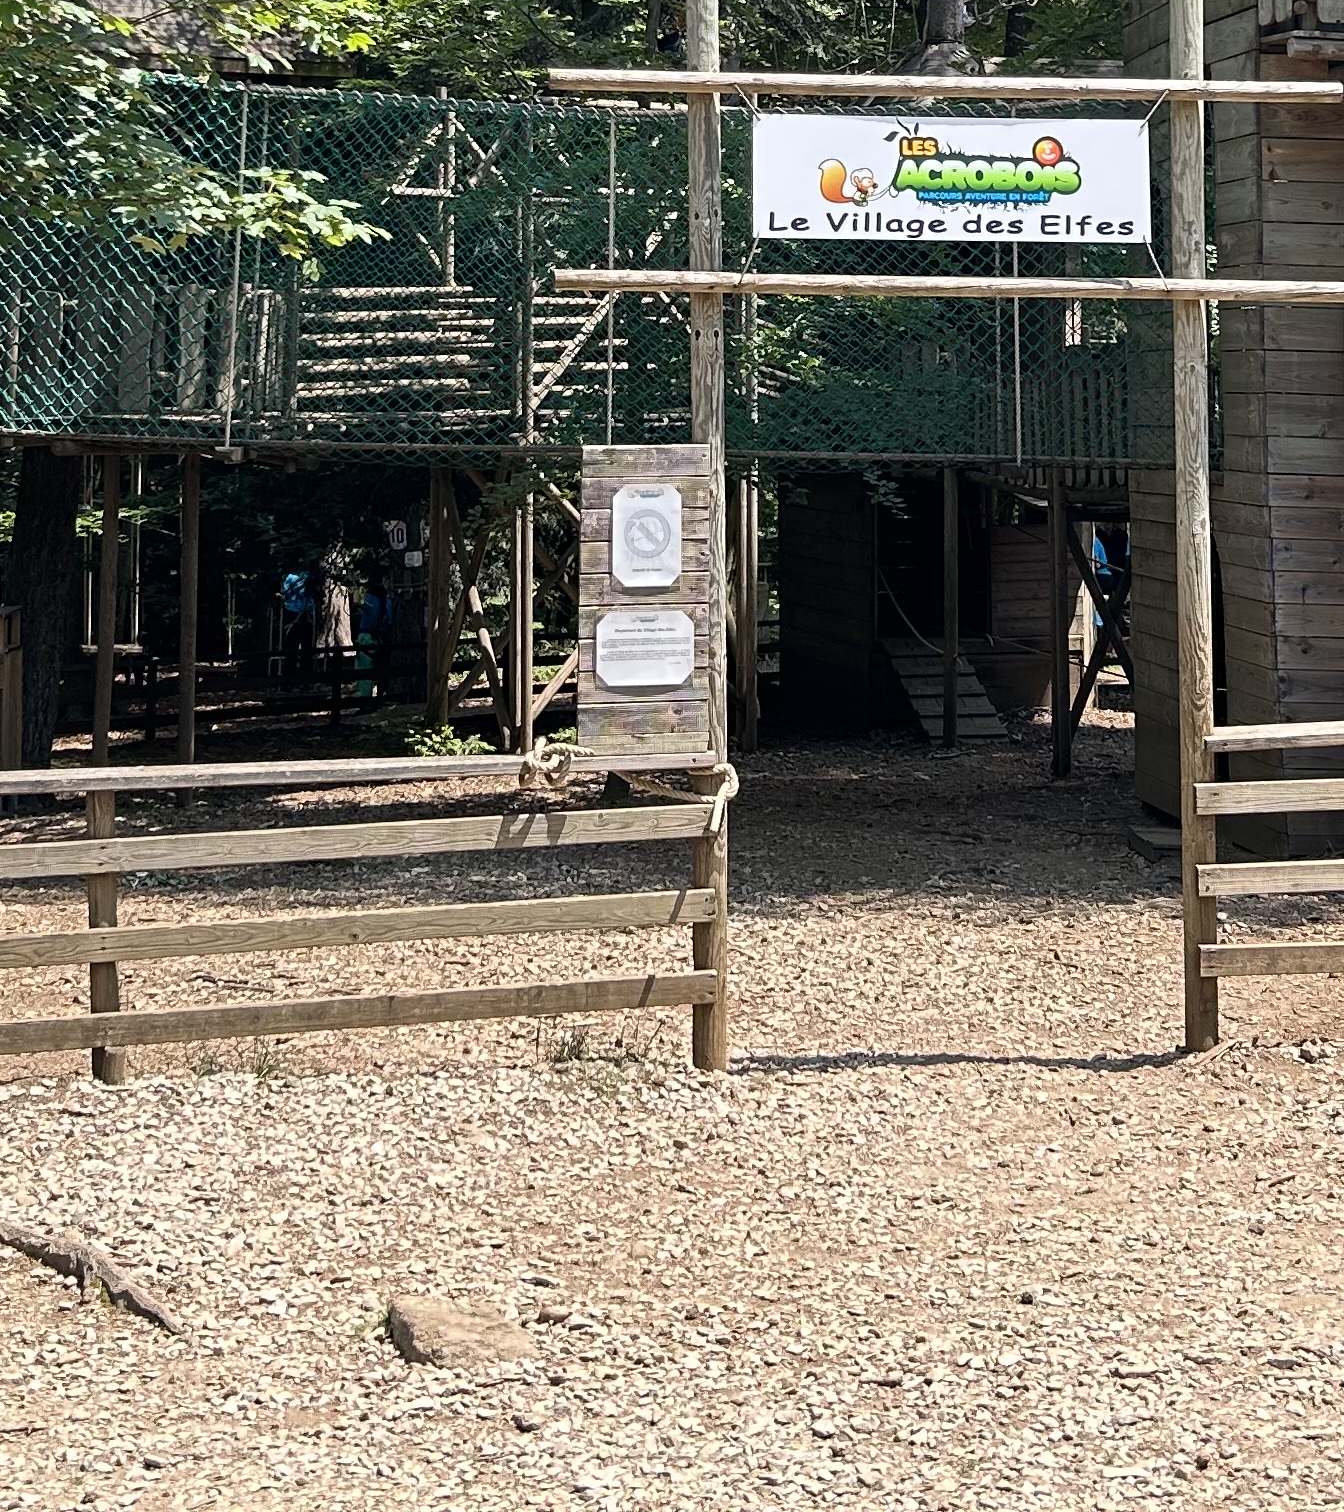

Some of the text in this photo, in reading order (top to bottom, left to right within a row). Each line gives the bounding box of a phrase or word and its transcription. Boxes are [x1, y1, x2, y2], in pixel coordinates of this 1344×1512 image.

[902, 139, 937, 156] LES
[896, 159, 1081, 192] ACROBOIS
[917, 191, 963, 201] PARCOURS
[965, 192, 1007, 201] AVENTURE
[1009, 193, 1021, 202] EN
[768, 211, 1135, 239] Le Village des Elfes
